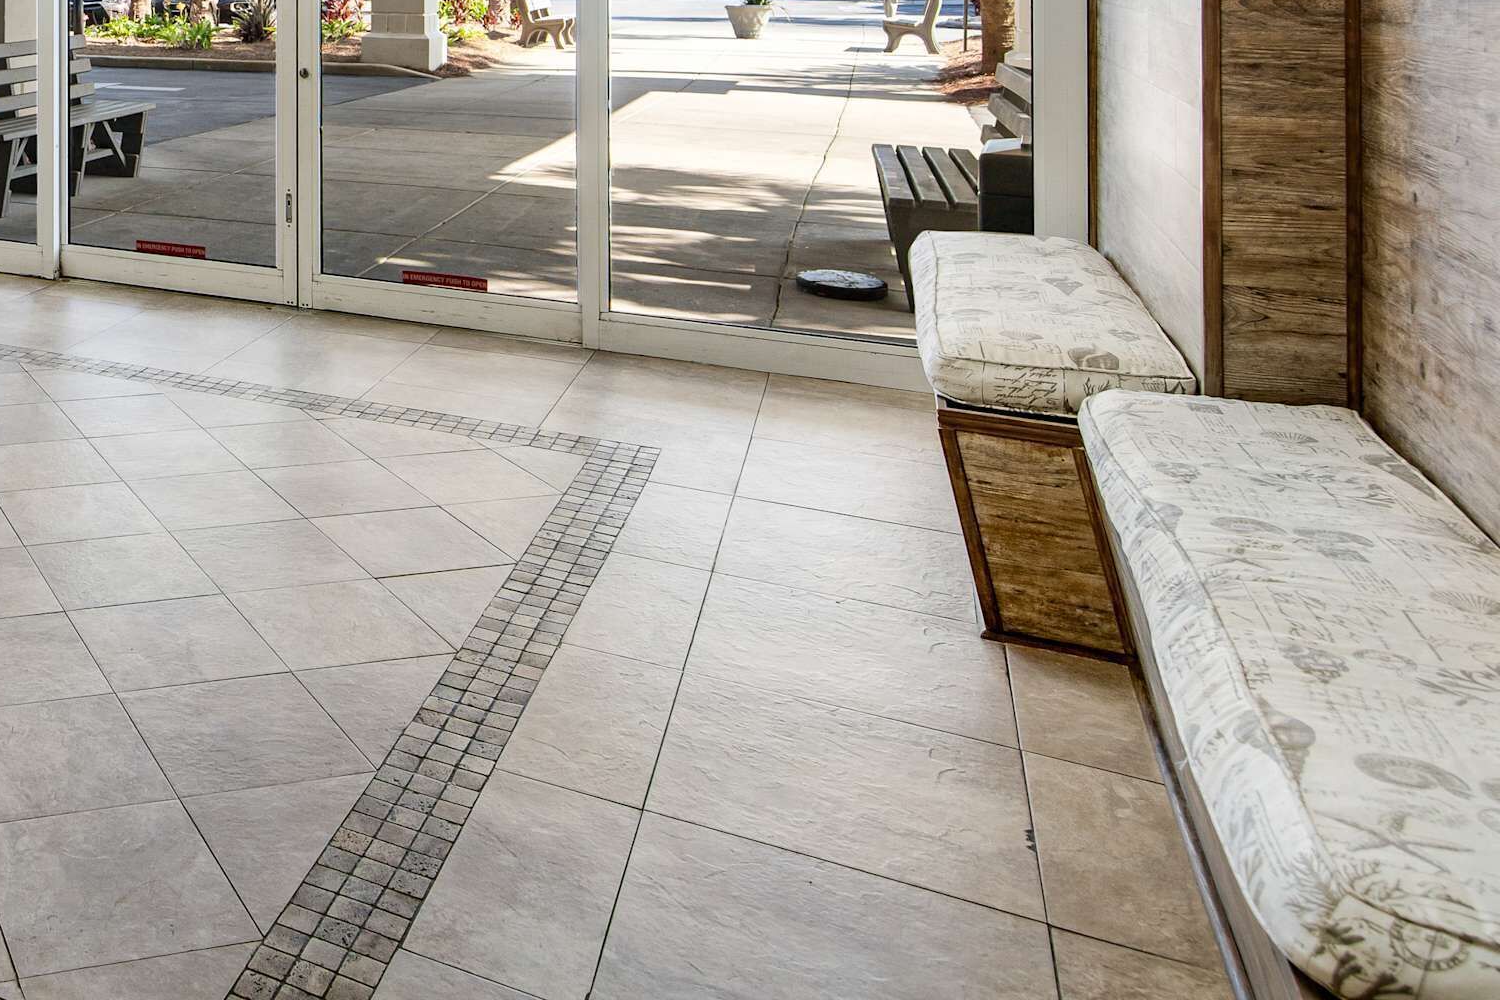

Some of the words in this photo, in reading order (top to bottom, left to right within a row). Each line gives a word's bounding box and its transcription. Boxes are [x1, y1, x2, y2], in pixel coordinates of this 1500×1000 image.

[410, 273, 444, 285] EMERGENCY
[445, 278, 462, 286] PUSH
[463, 279, 470, 287] TO
[471, 280, 487, 289] OPEN
